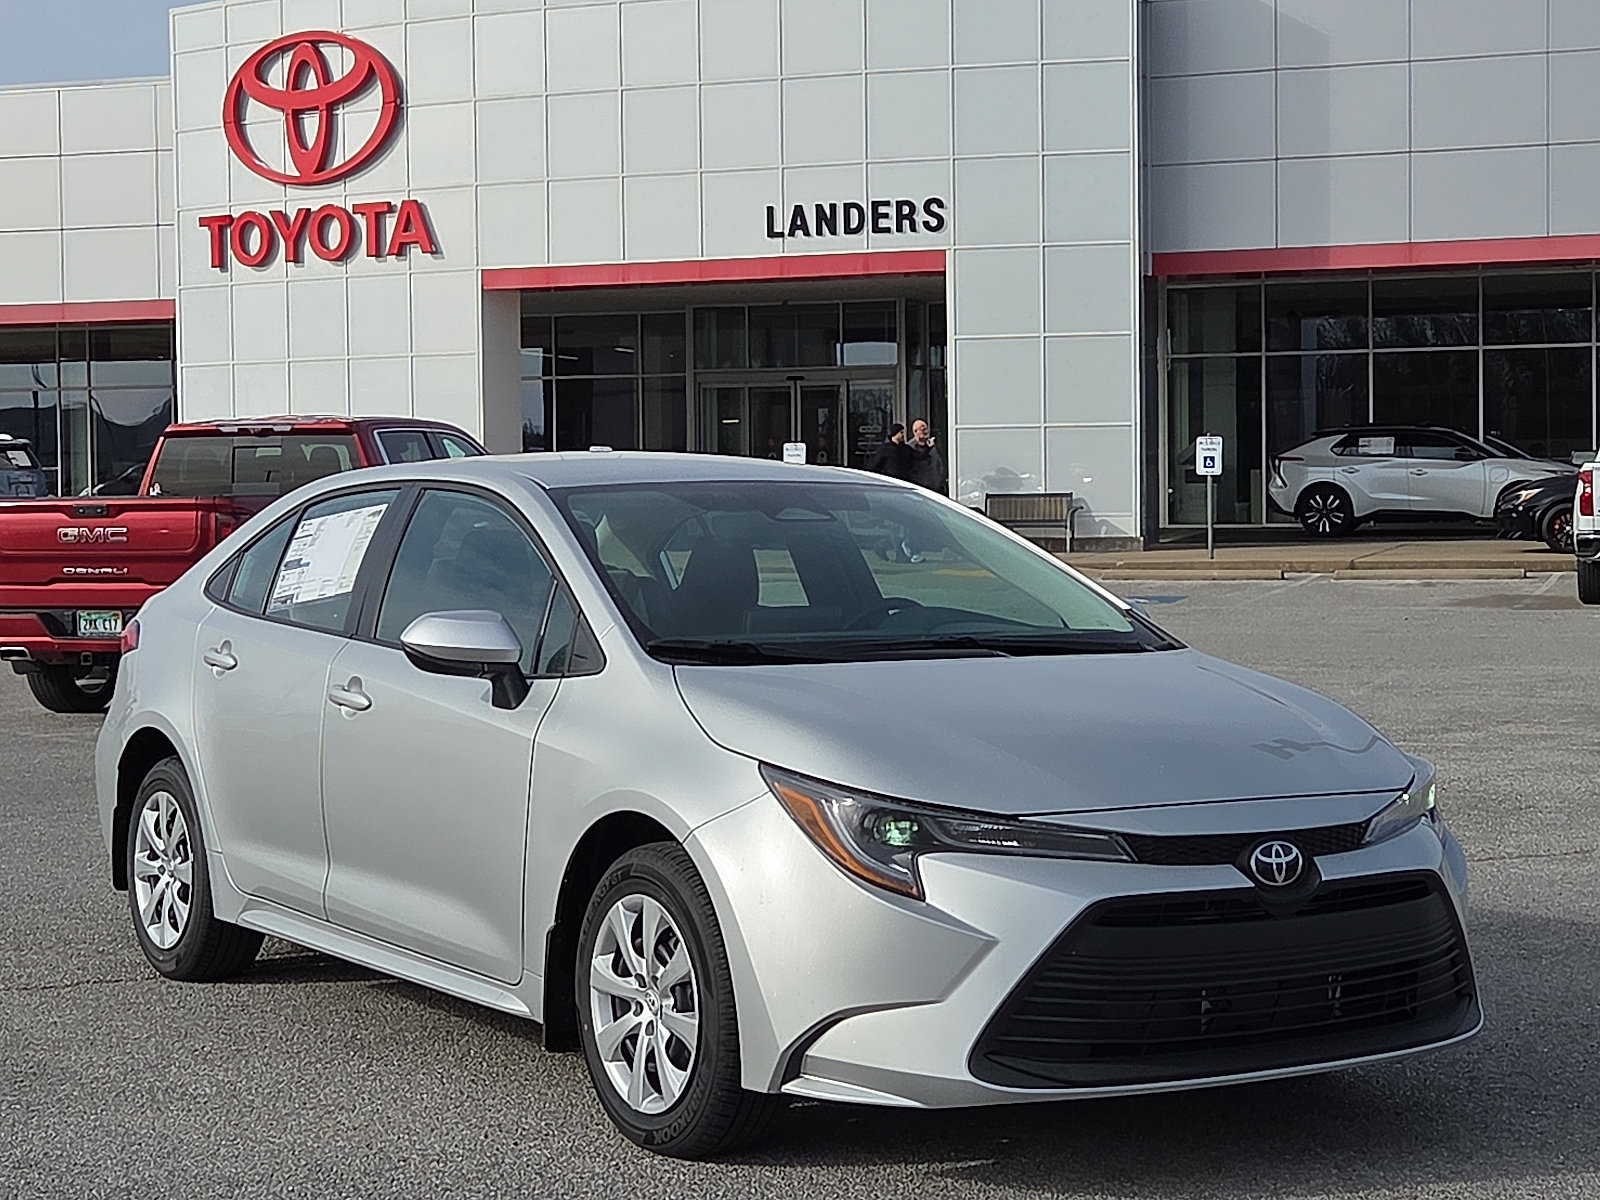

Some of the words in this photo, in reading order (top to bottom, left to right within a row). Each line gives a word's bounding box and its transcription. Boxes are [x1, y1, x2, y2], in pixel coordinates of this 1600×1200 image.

[199, 199, 435, 268] TOYOTA
[766, 198, 945, 238] LANDERS
[57, 527, 128, 543] GMC
